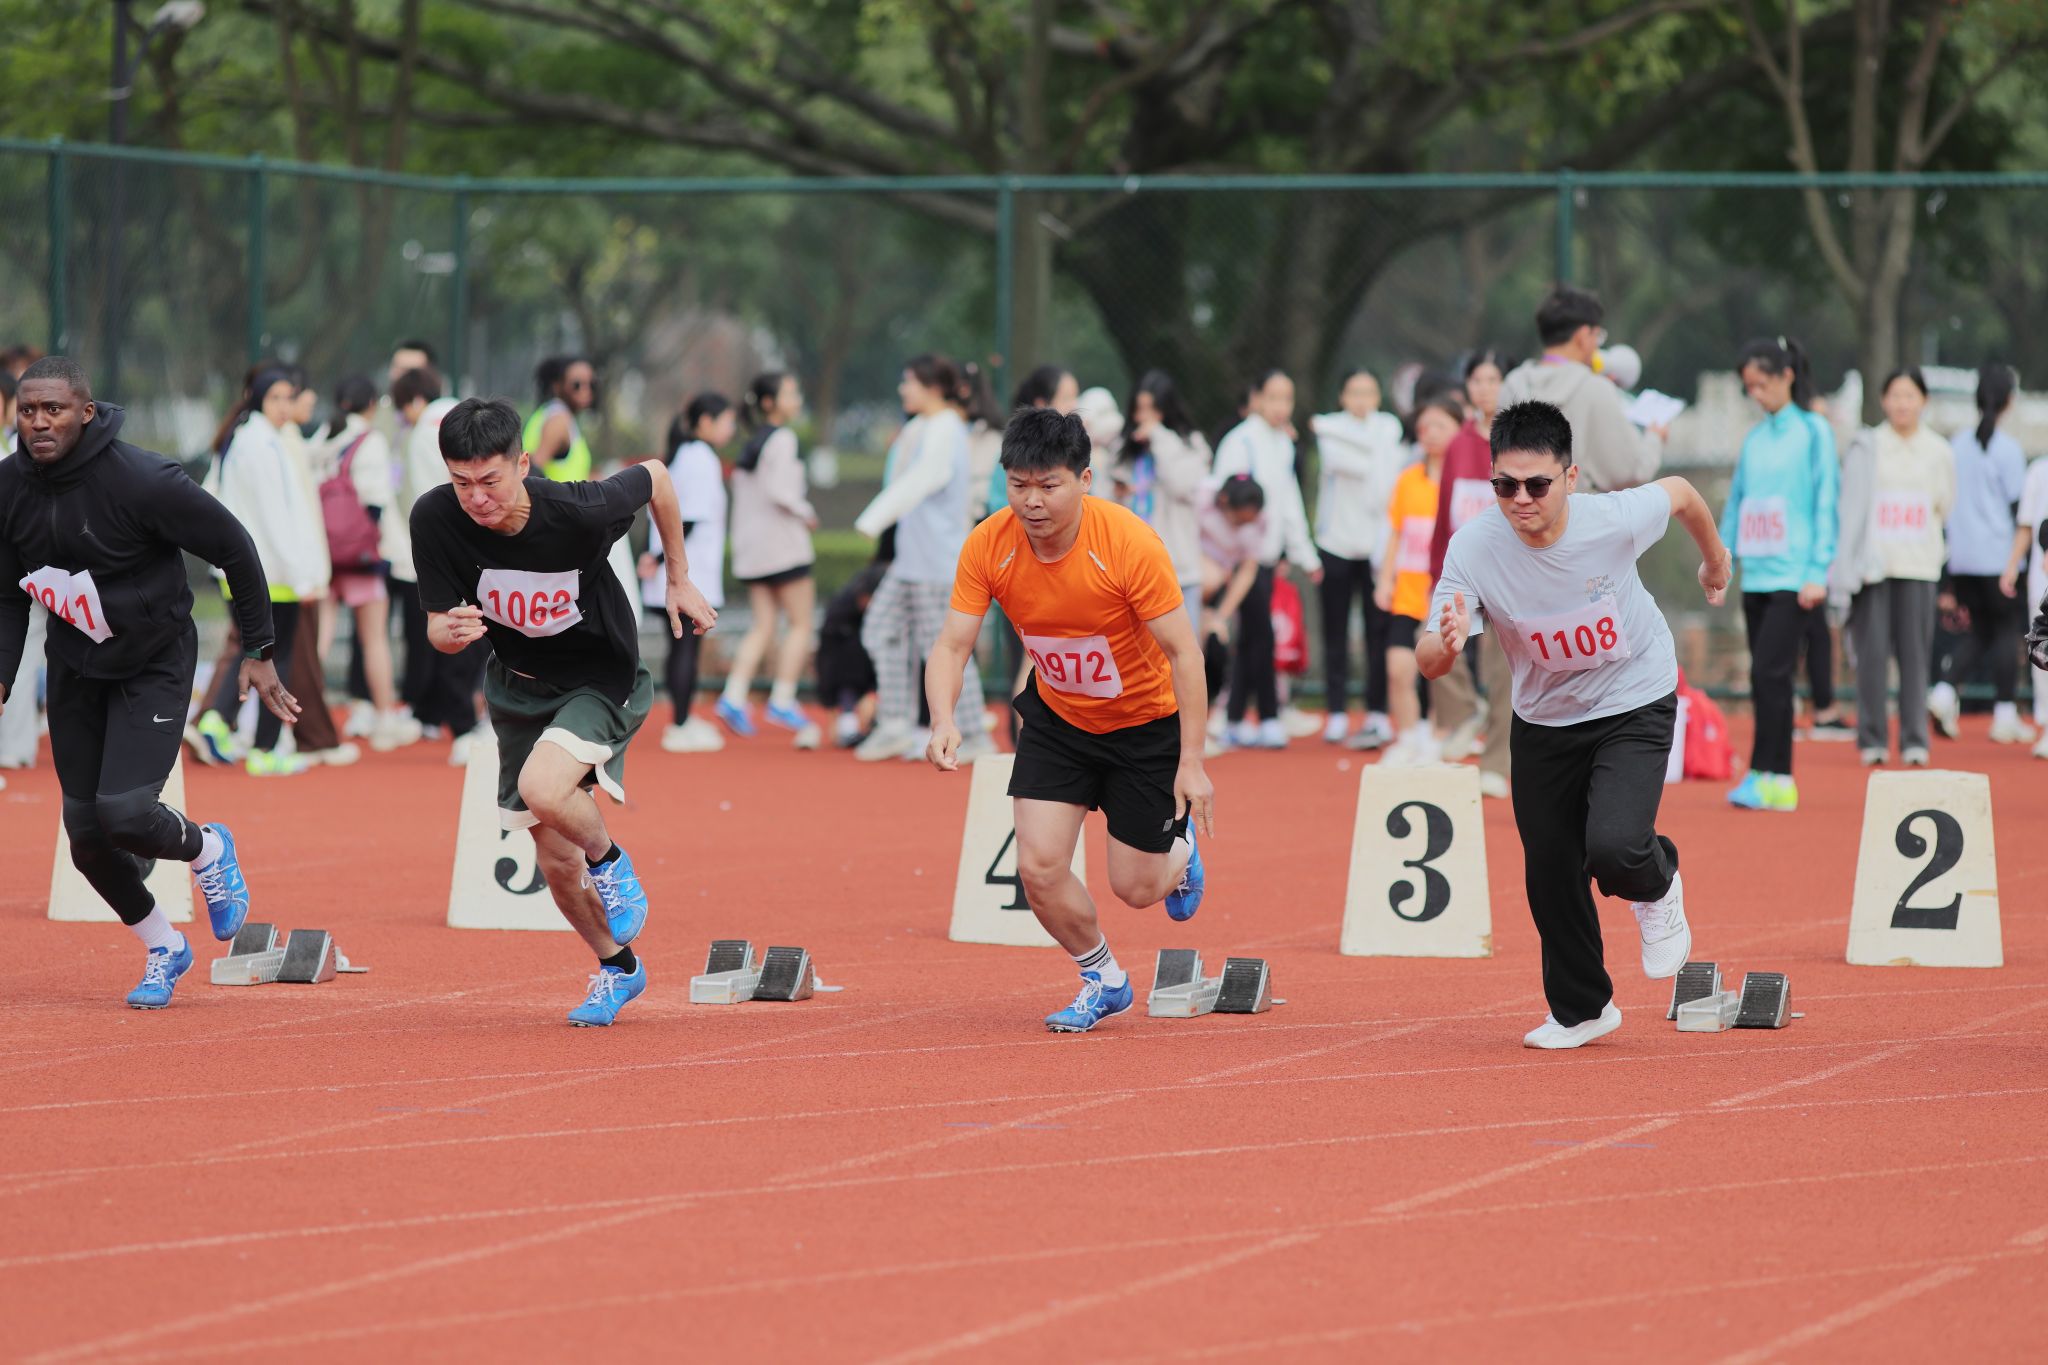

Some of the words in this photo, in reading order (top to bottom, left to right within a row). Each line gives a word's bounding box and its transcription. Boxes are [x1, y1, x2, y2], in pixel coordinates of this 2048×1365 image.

[488, 589, 571, 627] 1062
[1530, 617, 1618, 660] 1108
[1029, 648, 1112, 684] 0972
[1386, 801, 1453, 922] 3
[1890, 809, 1964, 930] 2
